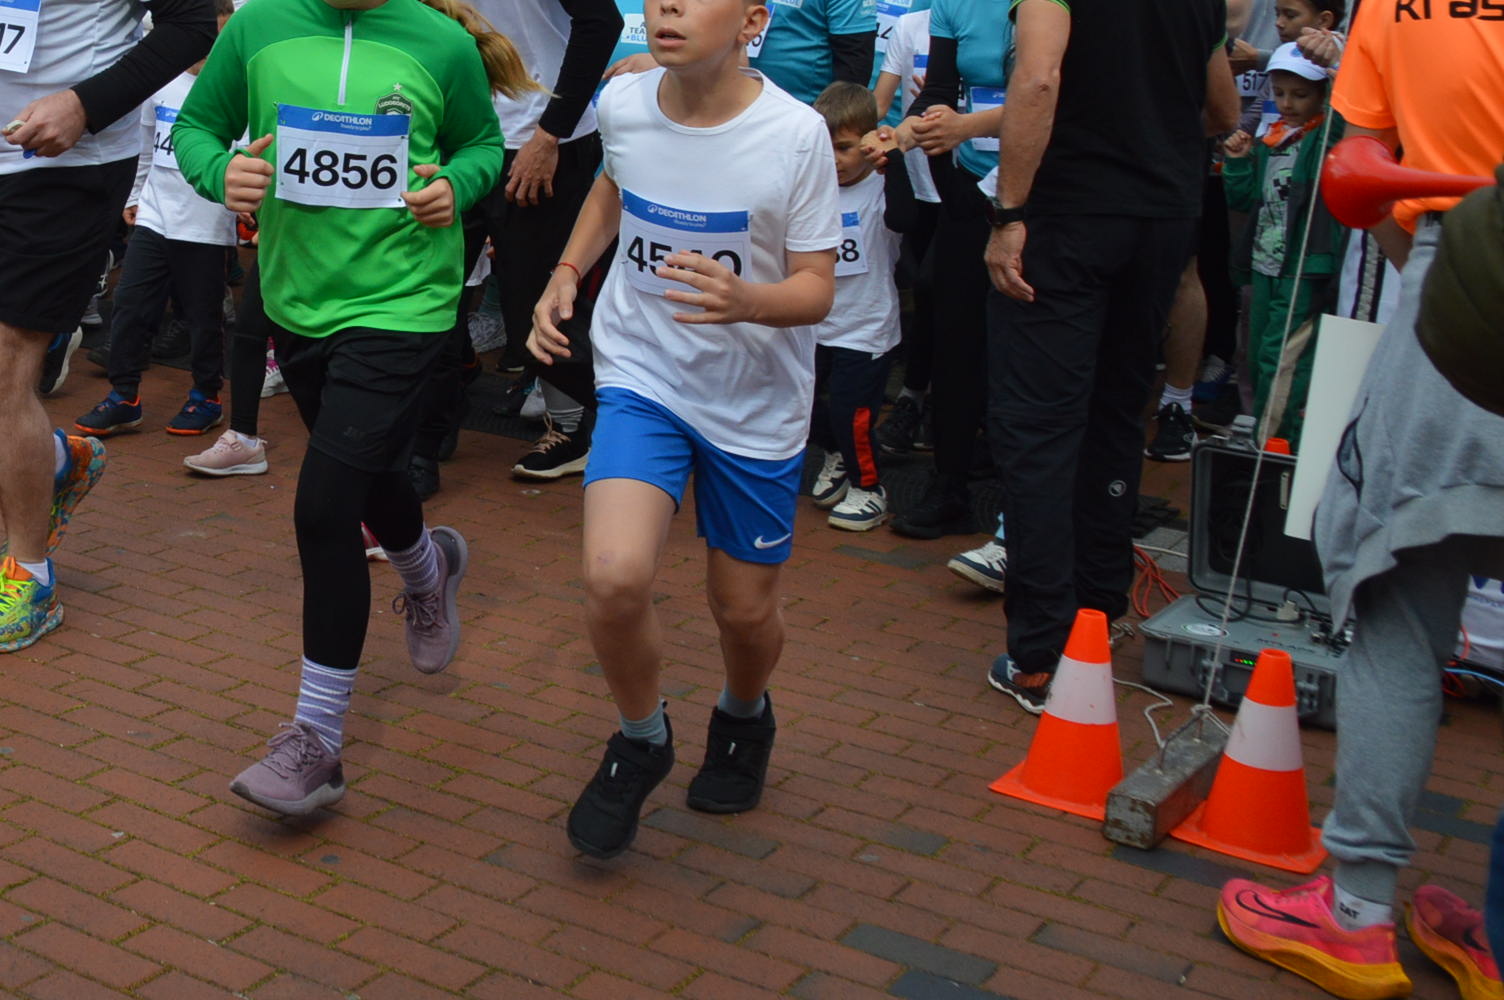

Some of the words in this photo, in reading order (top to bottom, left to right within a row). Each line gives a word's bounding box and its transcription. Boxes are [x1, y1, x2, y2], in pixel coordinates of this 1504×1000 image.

[323, 113, 373, 126] DECATHLON
[283, 147, 399, 190] 4856
[657, 207, 707, 223] DECATHLON
[627, 235, 743, 278] 450
